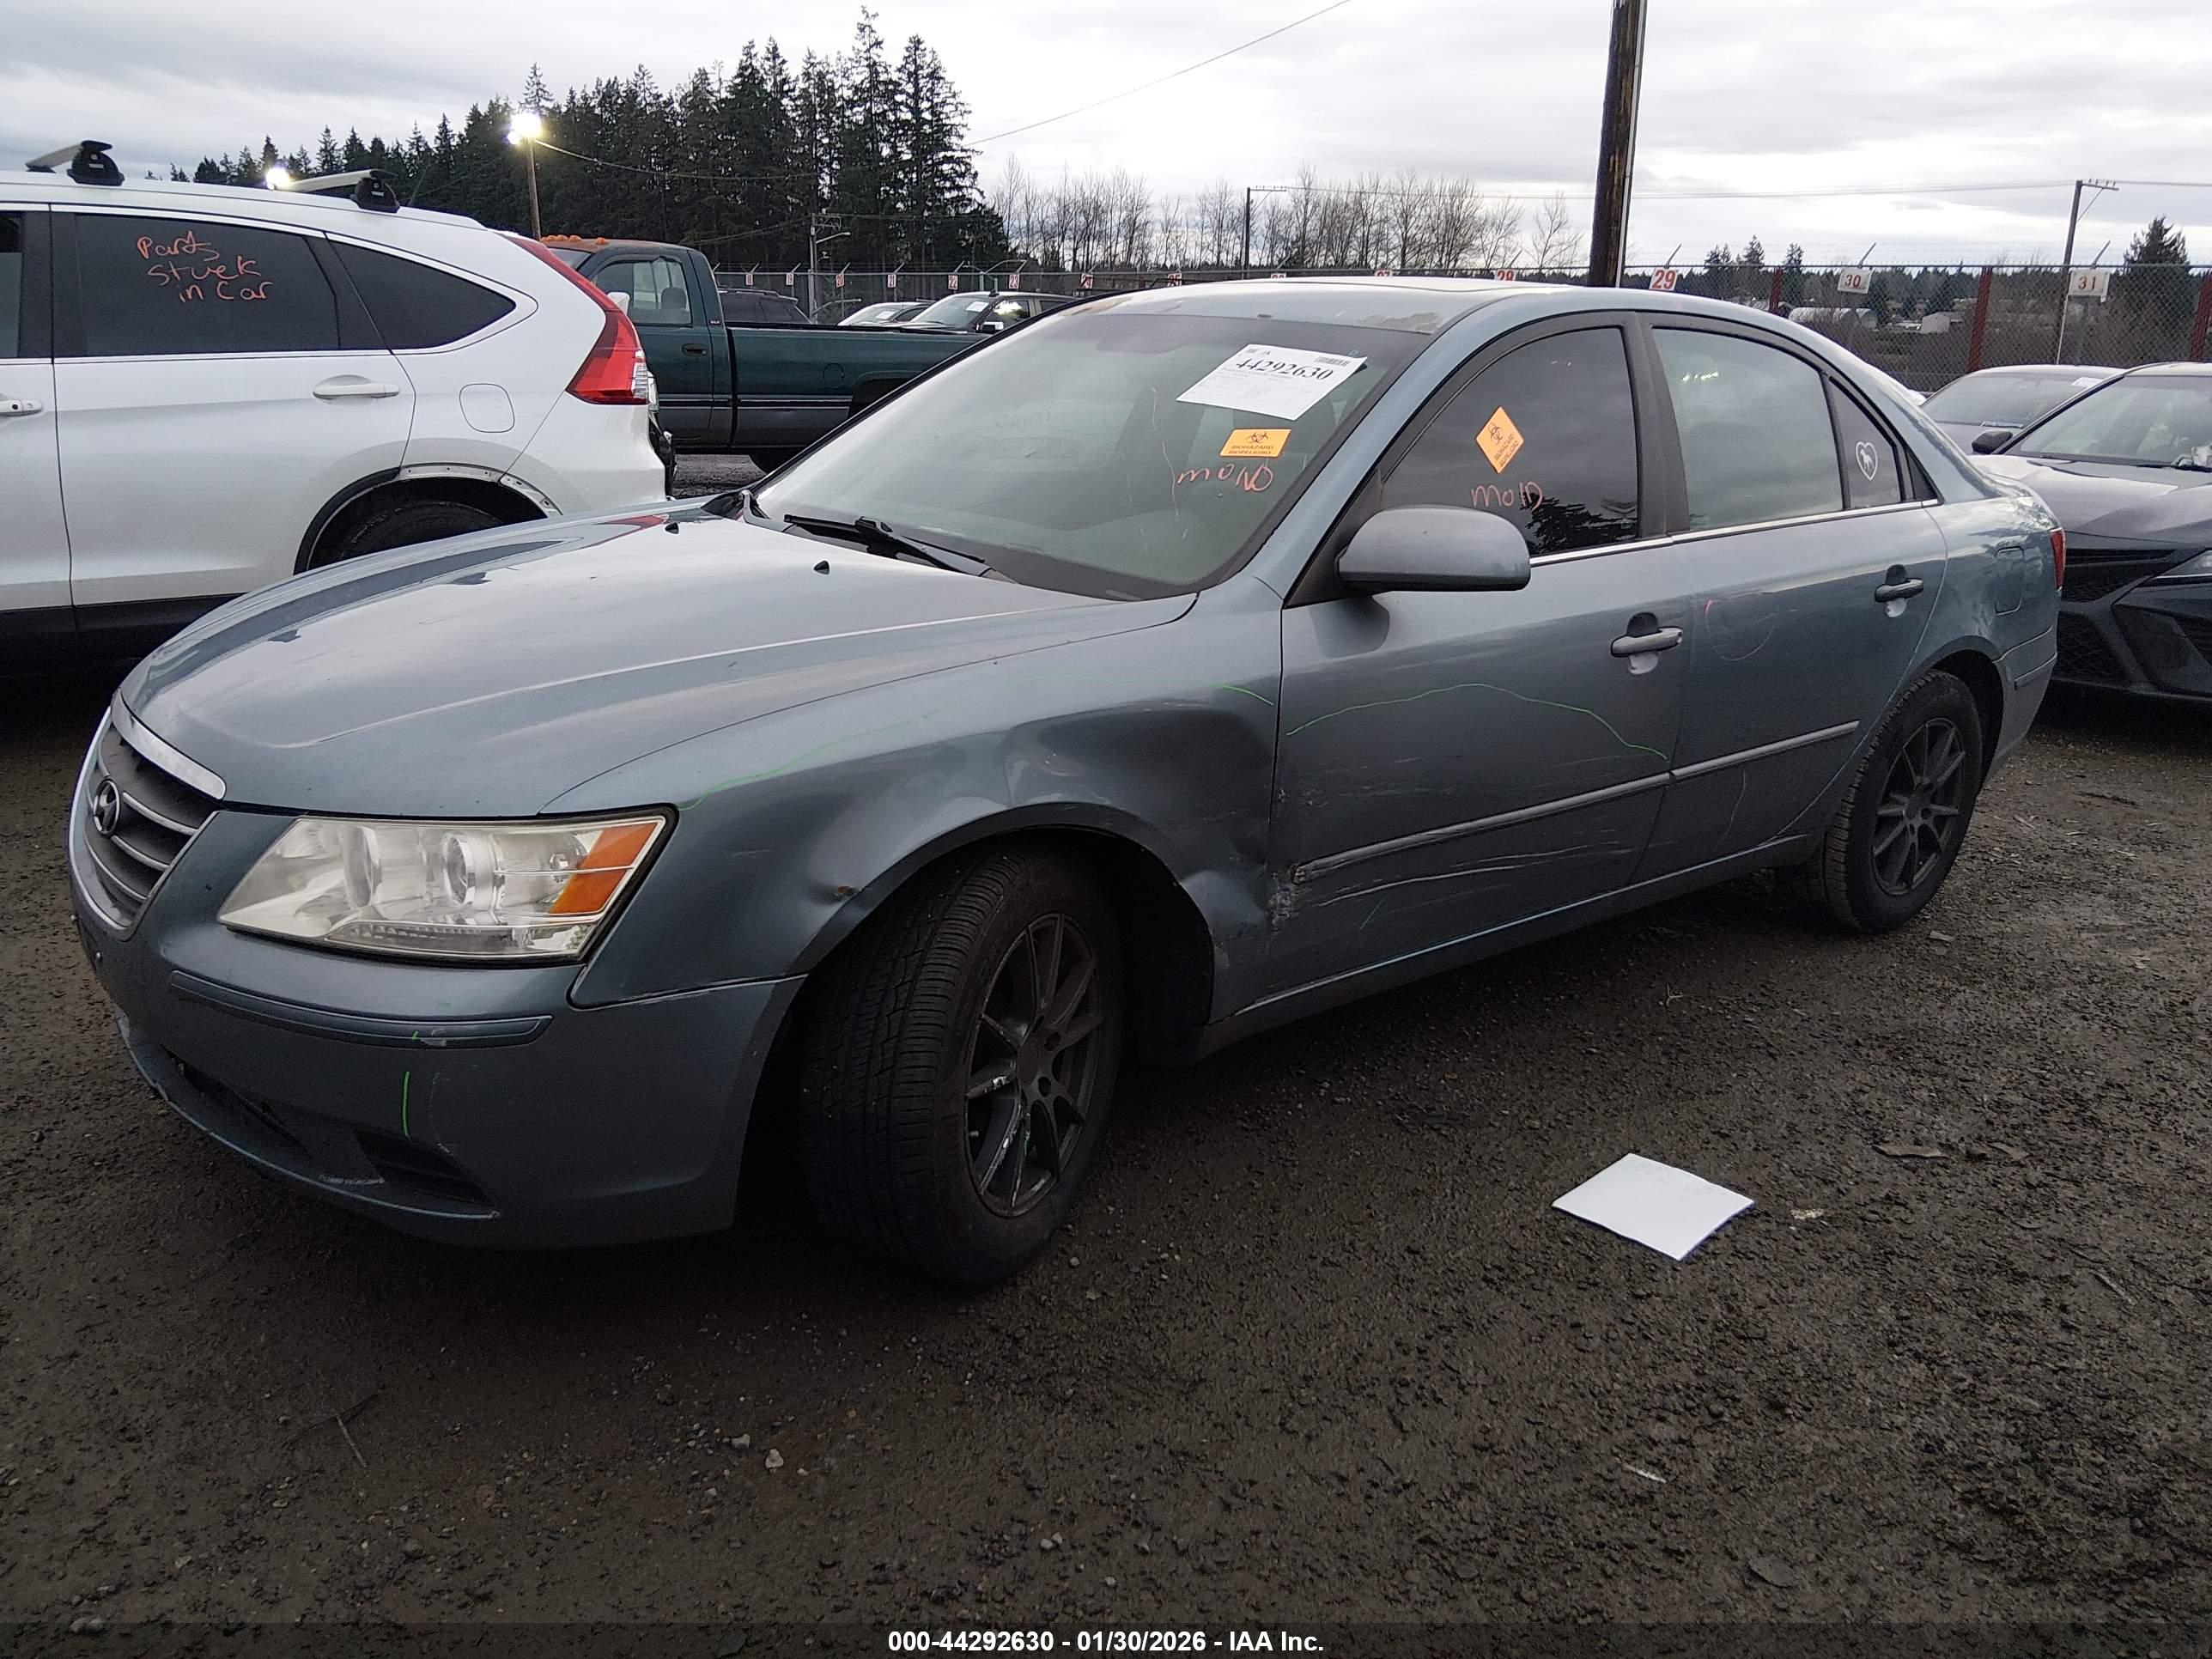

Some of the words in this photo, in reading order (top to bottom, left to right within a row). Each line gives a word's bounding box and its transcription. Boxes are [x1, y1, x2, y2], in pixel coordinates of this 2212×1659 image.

[137, 230, 220, 262] Parts
[949, 276, 957, 289] 22
[1010, 275, 1019, 289] 23
[1652, 270, 1676, 289] 29
[1844, 274, 1862, 289] 30
[2078, 275, 2097, 290] 31
[179, 284, 204, 302] in
[216, 280, 274, 301] Car
[1236, 357, 1334, 380] 44292630
